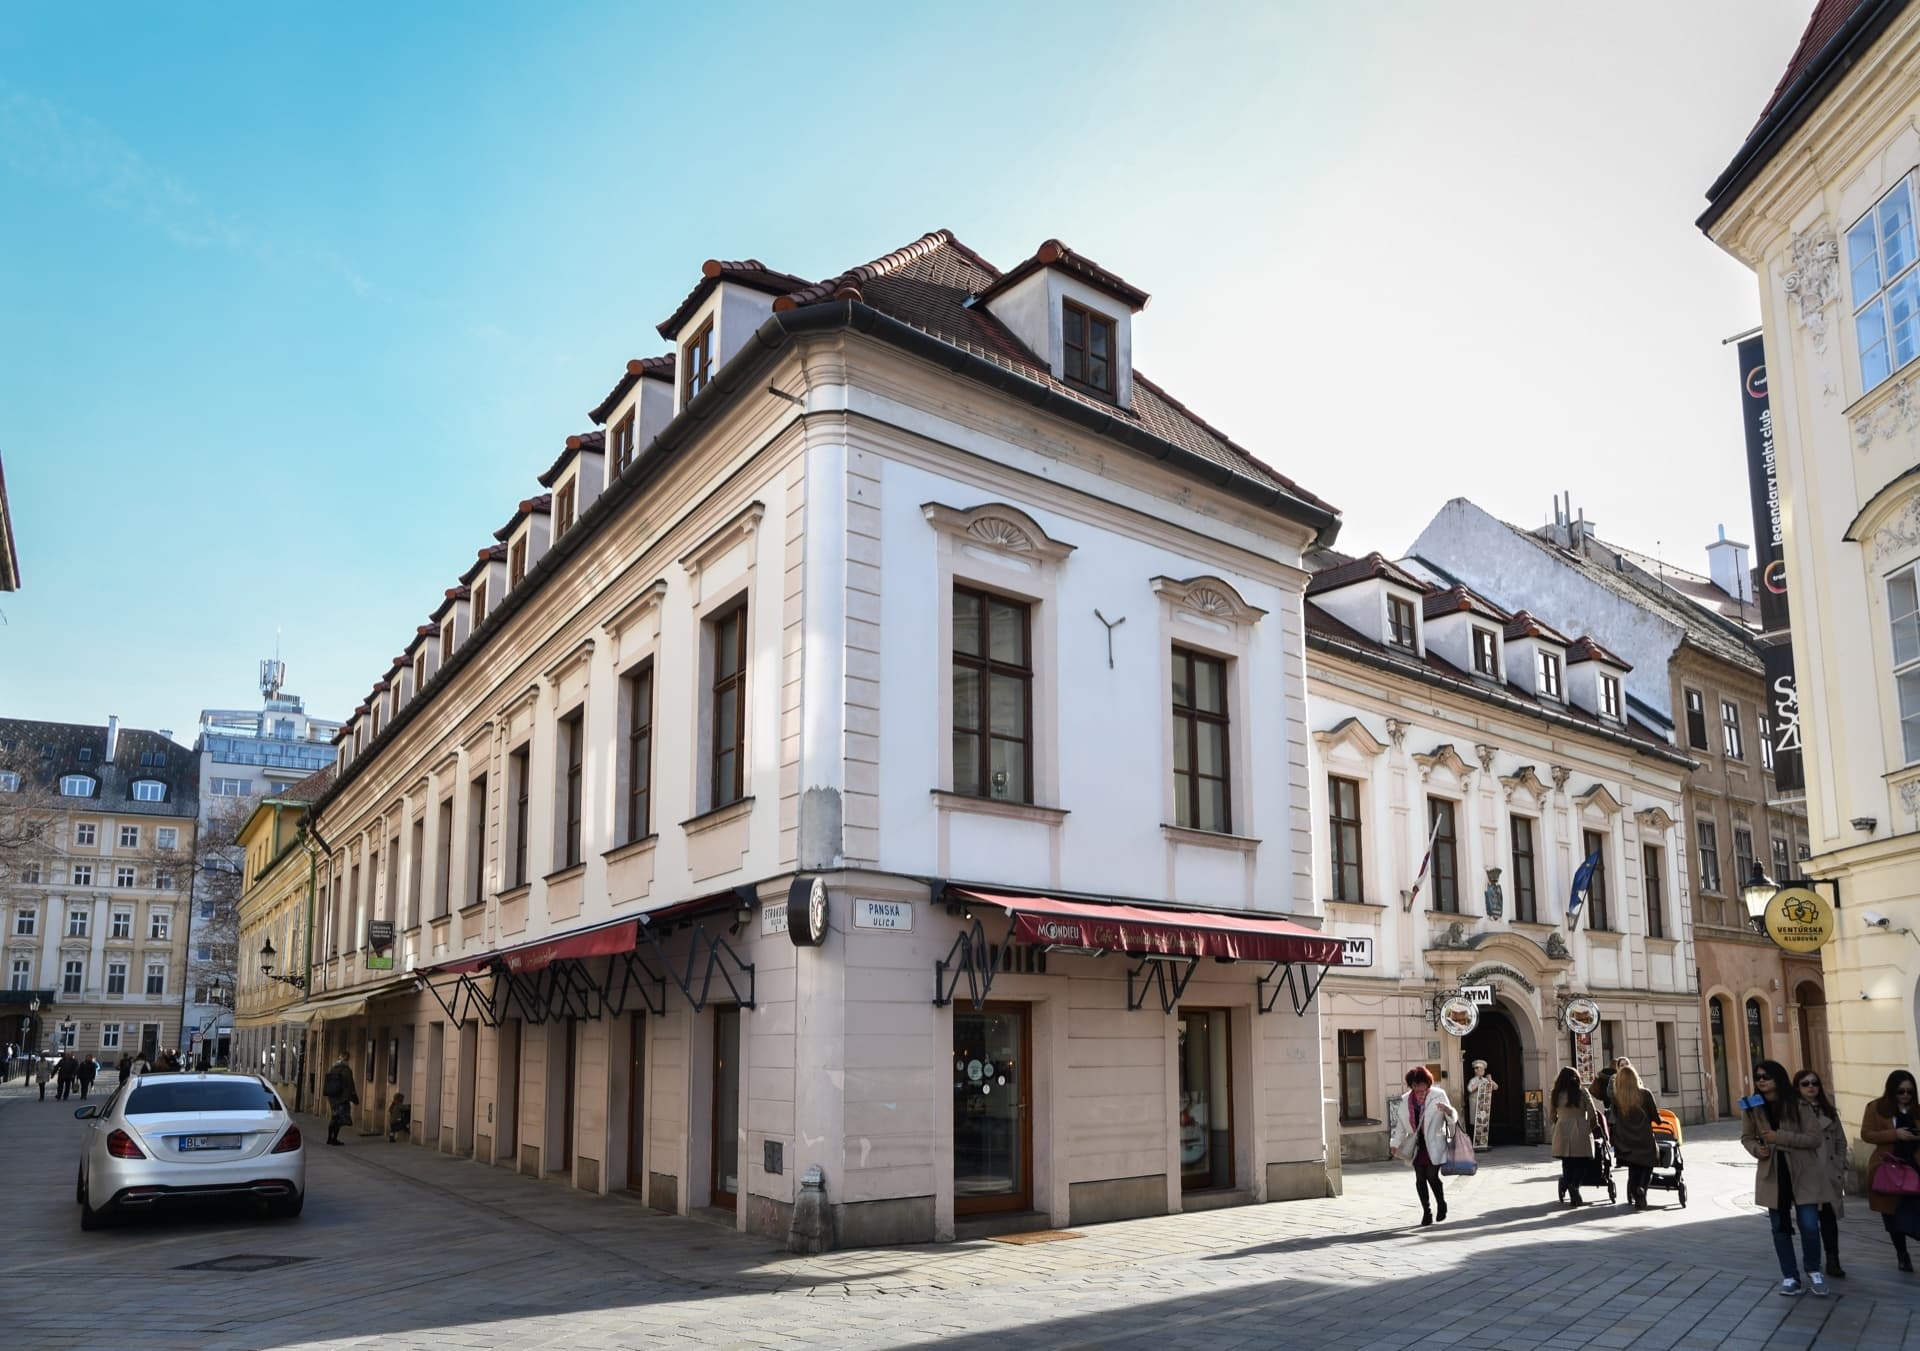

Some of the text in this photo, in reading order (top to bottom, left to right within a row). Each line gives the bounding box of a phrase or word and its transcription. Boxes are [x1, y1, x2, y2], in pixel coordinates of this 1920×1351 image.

[1759, 409, 1783, 547] legendary night club
[873, 917, 895, 927] ULICA
[1343, 940, 1365, 953] TM
[1464, 990, 1489, 1001] ATM
